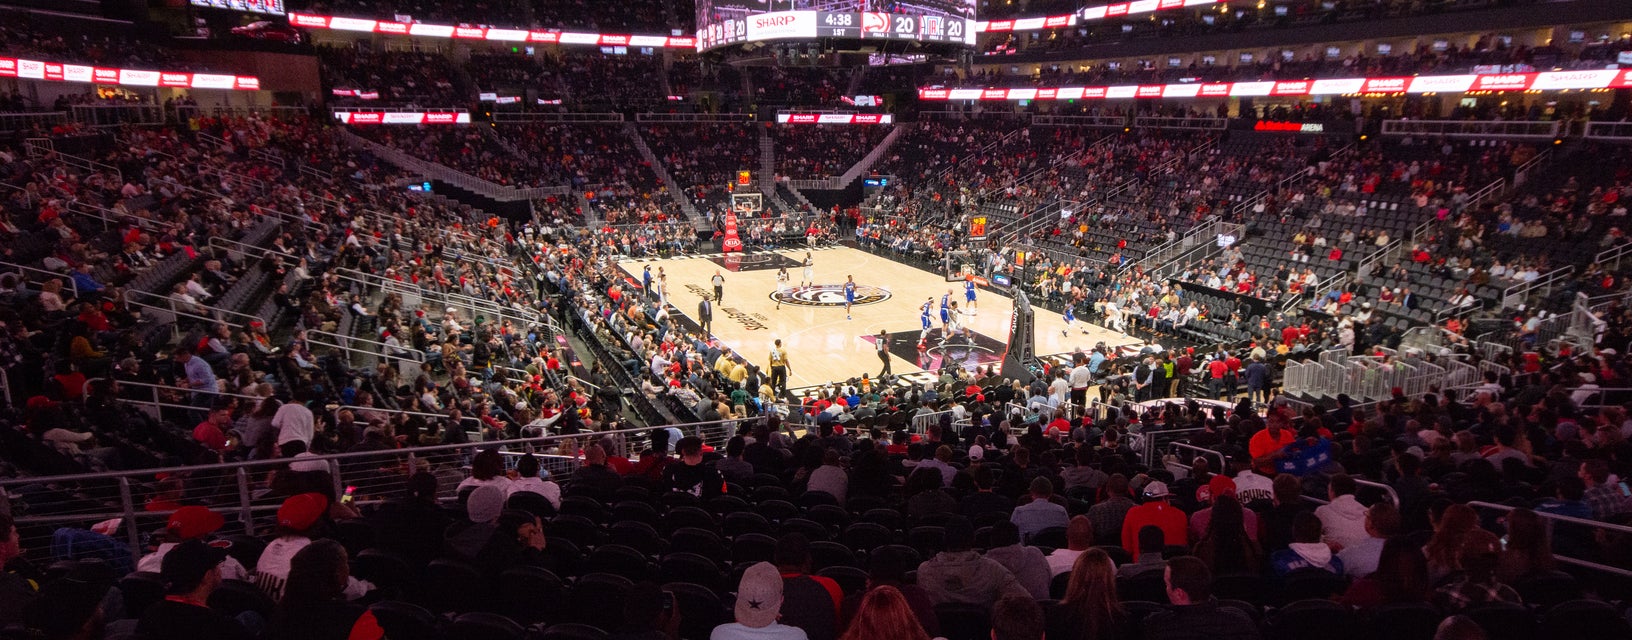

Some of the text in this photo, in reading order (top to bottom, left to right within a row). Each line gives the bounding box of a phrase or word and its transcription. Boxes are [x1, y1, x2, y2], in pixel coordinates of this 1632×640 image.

[756, 15, 797, 29] SHARP
[825, 14, 852, 26] 4:38
[895, 17, 914, 33] 20
[736, 21, 746, 36] 20
[947, 21, 963, 36] 20
[1301, 123, 1323, 132] ARENA
